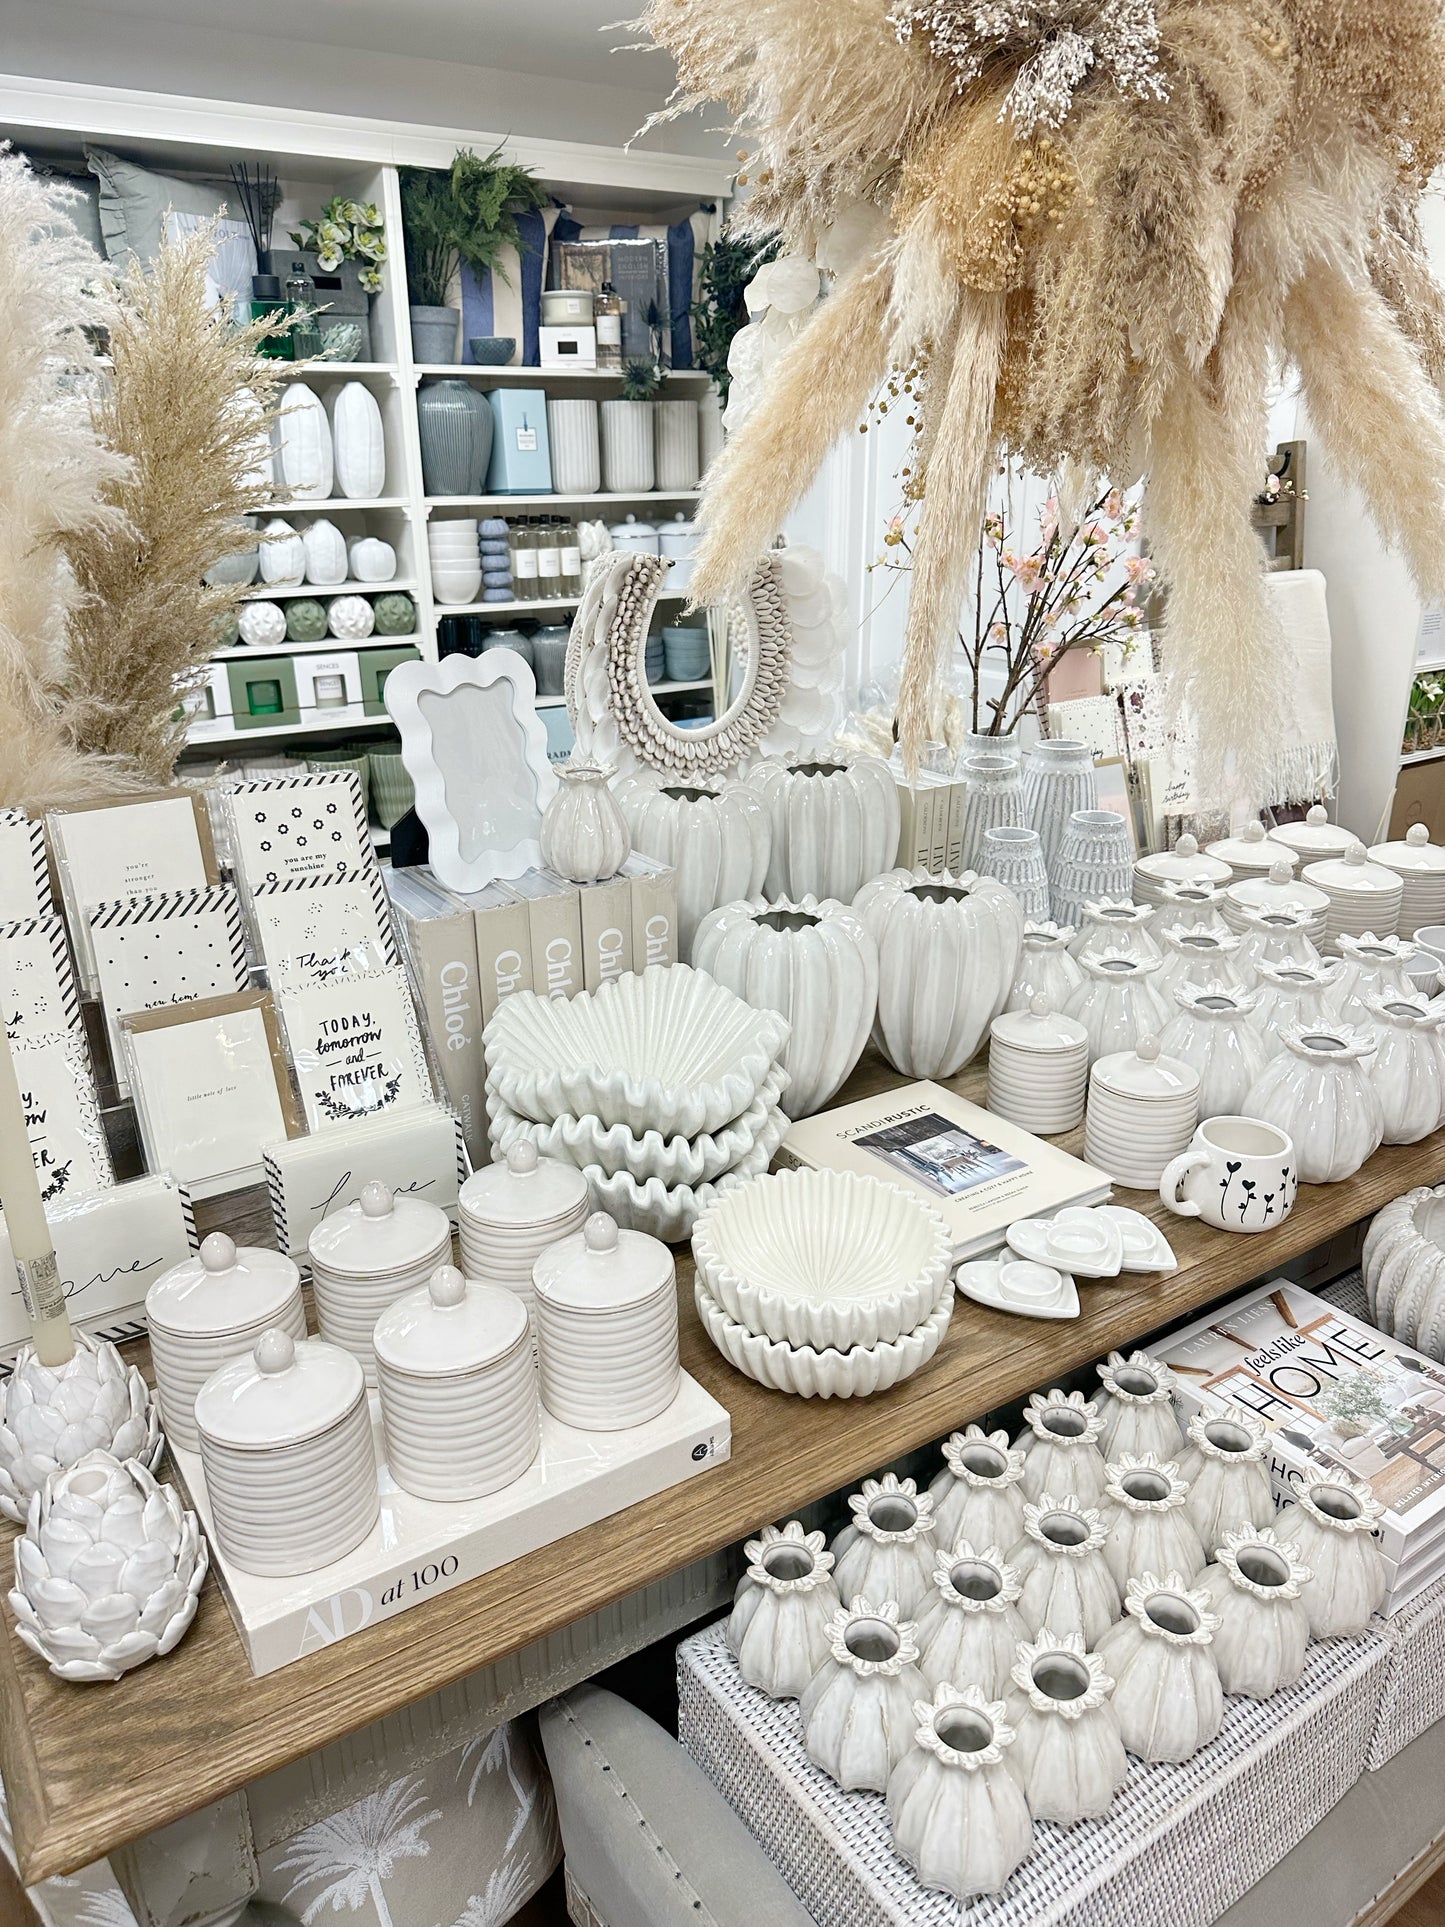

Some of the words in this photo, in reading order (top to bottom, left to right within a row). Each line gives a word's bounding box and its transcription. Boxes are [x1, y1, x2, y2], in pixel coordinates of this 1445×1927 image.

[126, 862, 149, 871] you're
[284, 857, 299, 865] you
[300, 854, 314, 862] are
[315, 852, 327, 861] my
[290, 862, 325, 873] sunshine
[124, 873, 155, 884] stronger
[645, 914, 670, 967] Chl
[545, 937, 574, 1002] Chl
[145, 999, 168, 1010] new
[171, 992, 200, 1004] home
[315, 1028, 382, 1055] tomorrow
[345, 1047, 366, 1065] and
[461, 1094, 475, 1142] CATWALK
[1183, 1320, 1237, 1355] LAUREN
[1239, 1300, 1277, 1325] LIESS
[1244, 1346, 1282, 1377] feels
[1279, 1333, 1306, 1356] like
[1232, 1328, 1386, 1422] HOME
[1394, 1486, 1424, 1508] RELAXED
[298, 1587, 374, 1659] AD
[381, 1579, 405, 1606] at
[412, 1555, 459, 1592] 100
